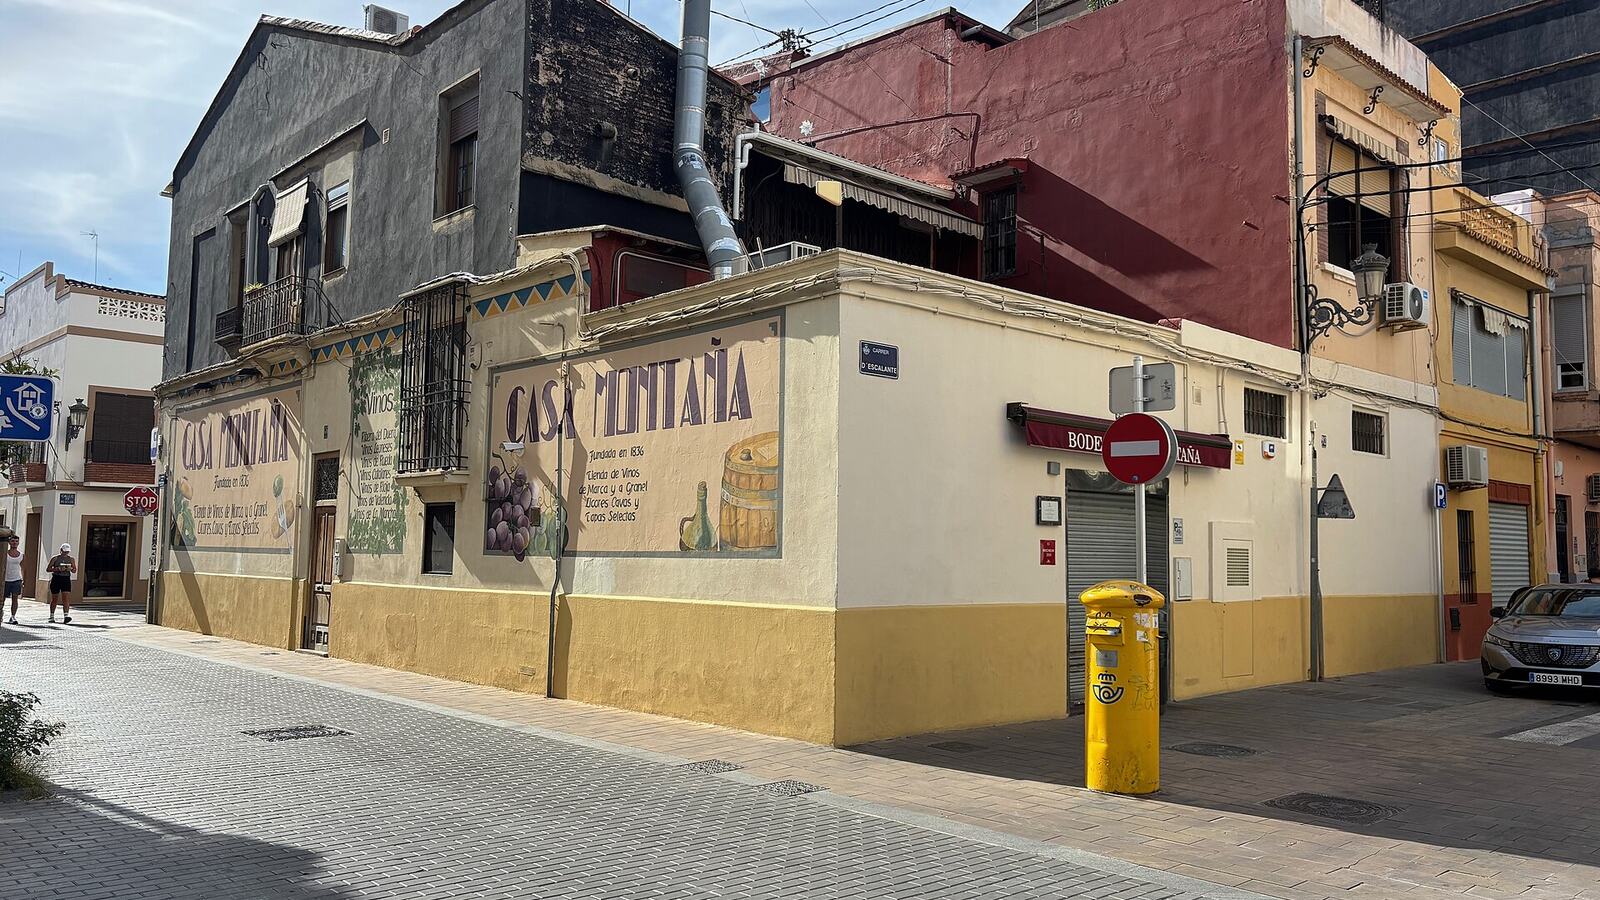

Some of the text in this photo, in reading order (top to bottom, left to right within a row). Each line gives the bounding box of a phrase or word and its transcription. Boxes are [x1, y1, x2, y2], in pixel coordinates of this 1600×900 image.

[506, 337, 752, 443] CASA MONTAÑA
[365, 392, 394, 415] Vinos
[182, 420, 213, 470] CASA
[219, 398, 288, 469] MONTAÑA
[589, 445, 644, 463] Fundada en 1836
[1068, 431, 1201, 464] BODE TAÑA
[360, 457, 372, 468] Vinos
[373, 457, 379, 468] de
[586, 468, 640, 480] Tienda de Vinos
[578, 484, 586, 494] de
[610, 484, 616, 496] y
[618, 484, 623, 492] a
[626, 480, 648, 496] Granel
[1437, 485, 1444, 507] P
[126, 496, 156, 508] STOP
[611, 496, 632, 508] Cavas
[634, 498, 640, 510] y
[585, 512, 606, 524] Tapas
[1536, 674, 1580, 684] 8993 MHD
